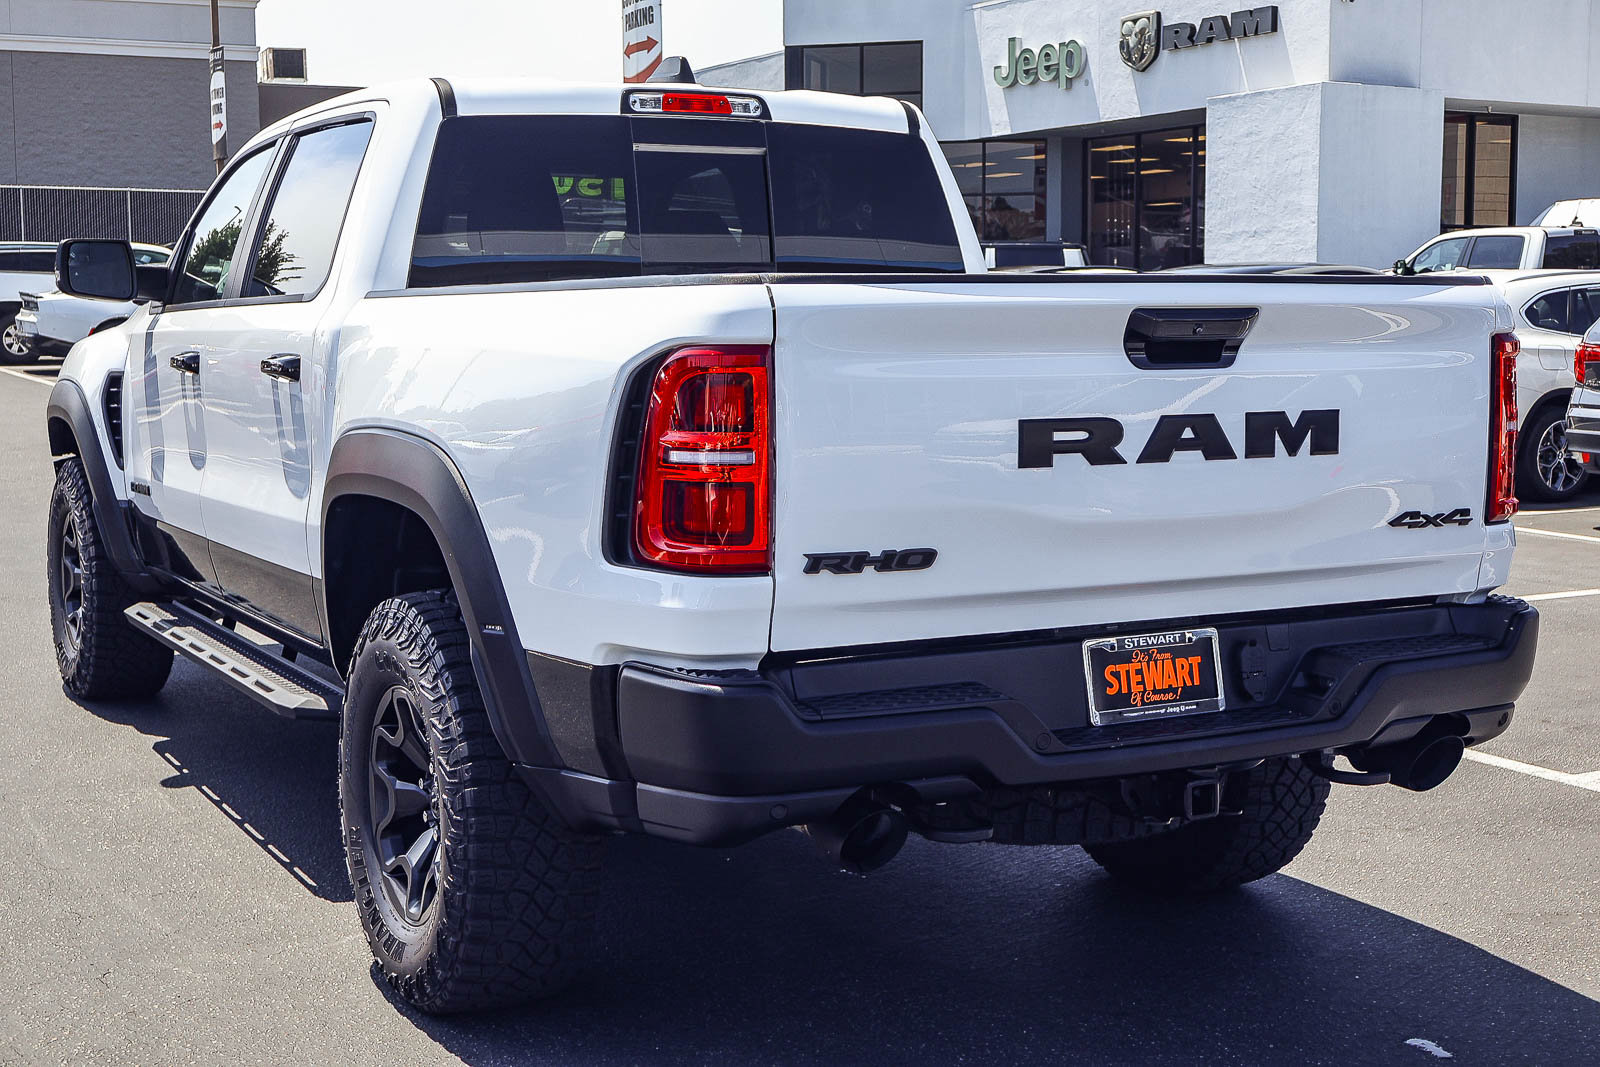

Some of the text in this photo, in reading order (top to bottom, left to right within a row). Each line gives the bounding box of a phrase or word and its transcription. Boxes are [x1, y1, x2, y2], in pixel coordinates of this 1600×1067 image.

[625, 6, 655, 32] PARKING
[1162, 5, 1279, 50] RAM
[993, 37, 1089, 89] Jeep
[1018, 409, 1340, 469] RAM
[1388, 508, 1473, 529] 4x4
[802, 548, 938, 574] RHO
[1124, 634, 1181, 648] STEWART
[1131, 649, 1173, 662] It's From
[1104, 655, 1202, 695] STEWART
[1130, 691, 1143, 707] Of
[349, 826, 407, 963] WRANGLER
